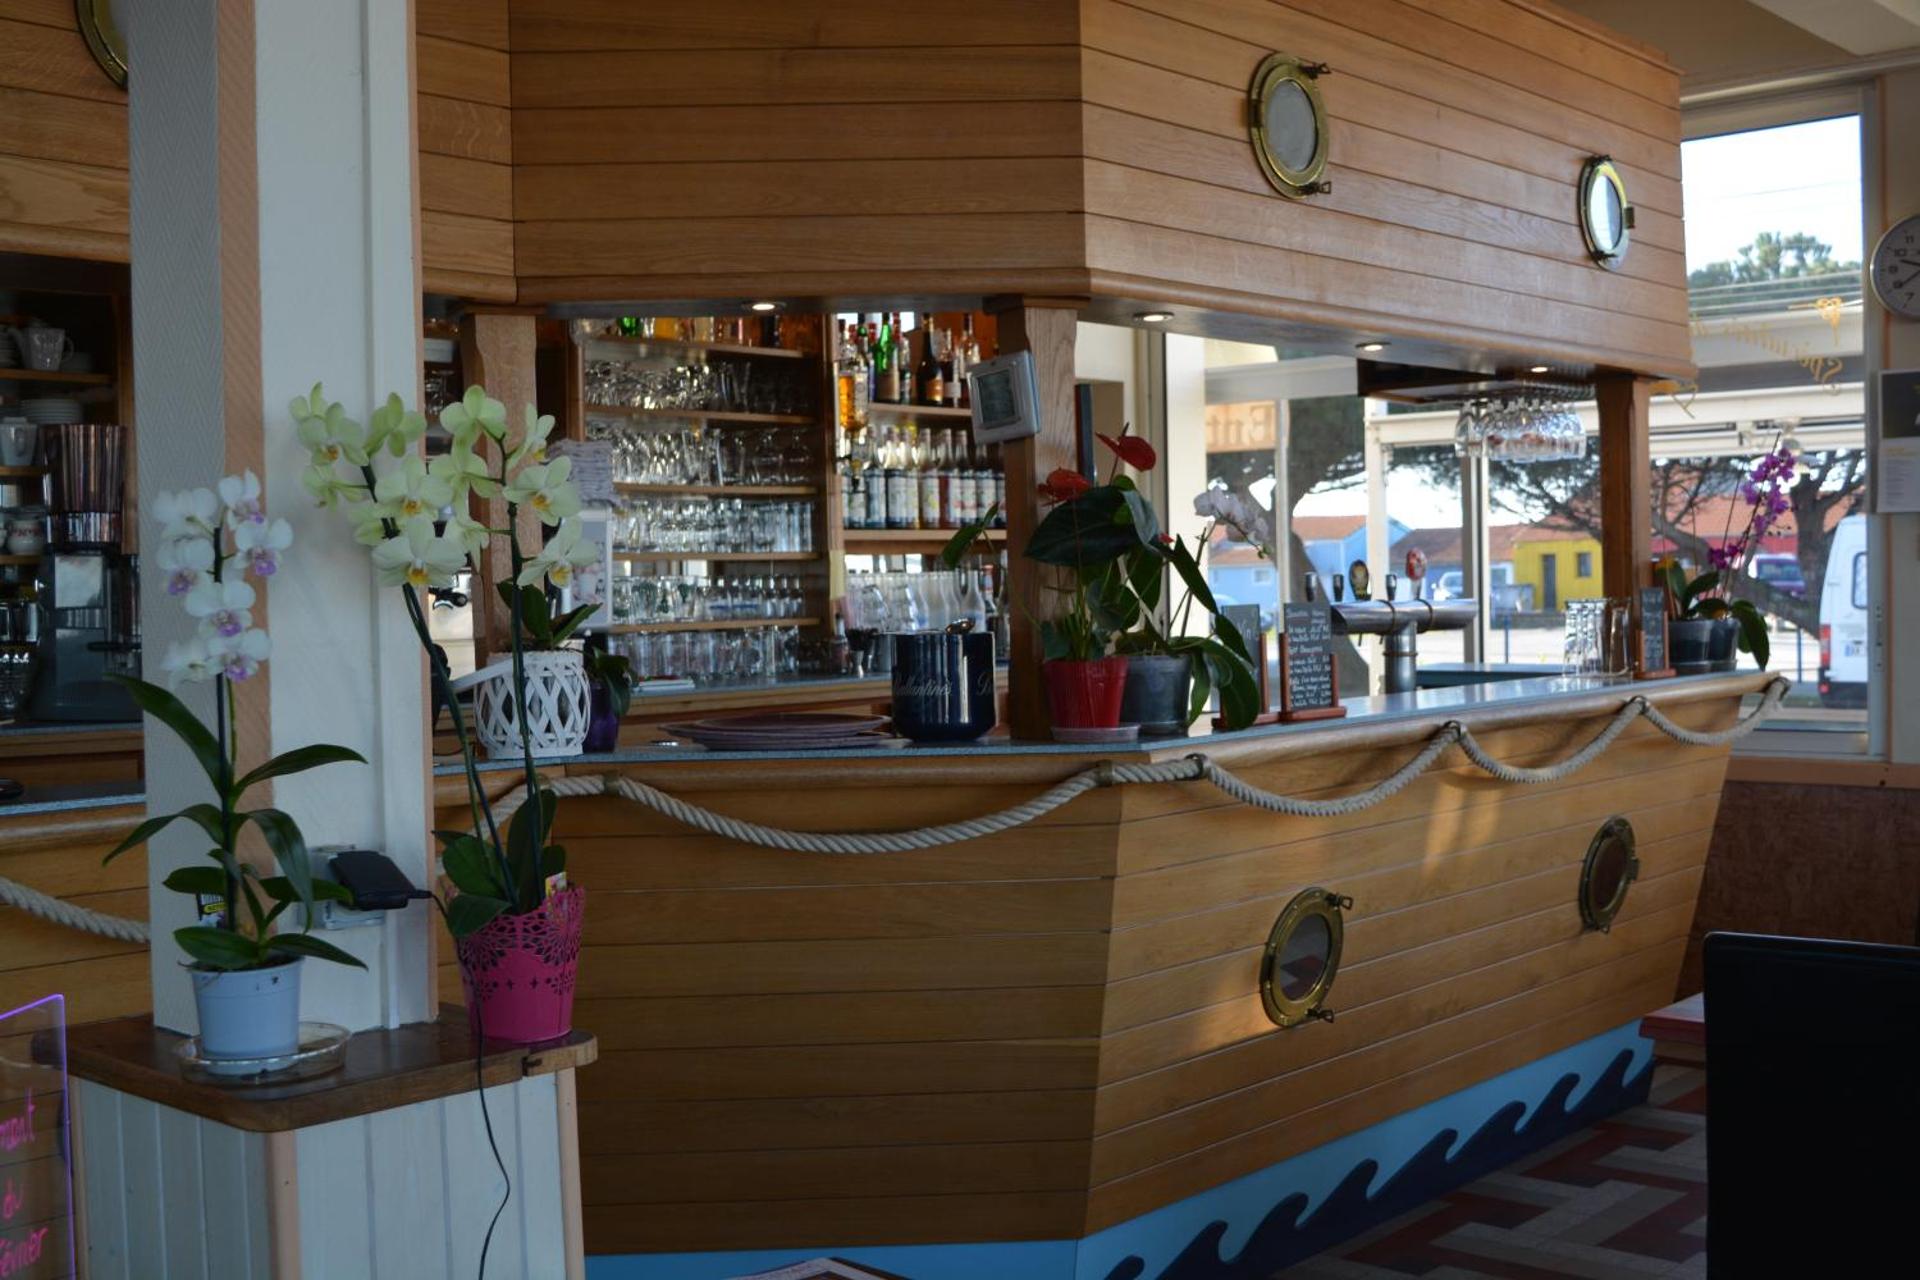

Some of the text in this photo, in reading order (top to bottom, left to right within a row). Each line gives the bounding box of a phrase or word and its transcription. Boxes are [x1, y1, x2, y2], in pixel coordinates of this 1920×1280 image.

[1905, 235, 1914, 244] 11
[1894, 248, 1907, 257] 10
[1888, 265, 1898, 274] 9
[1905, 292, 1915, 300] 7
